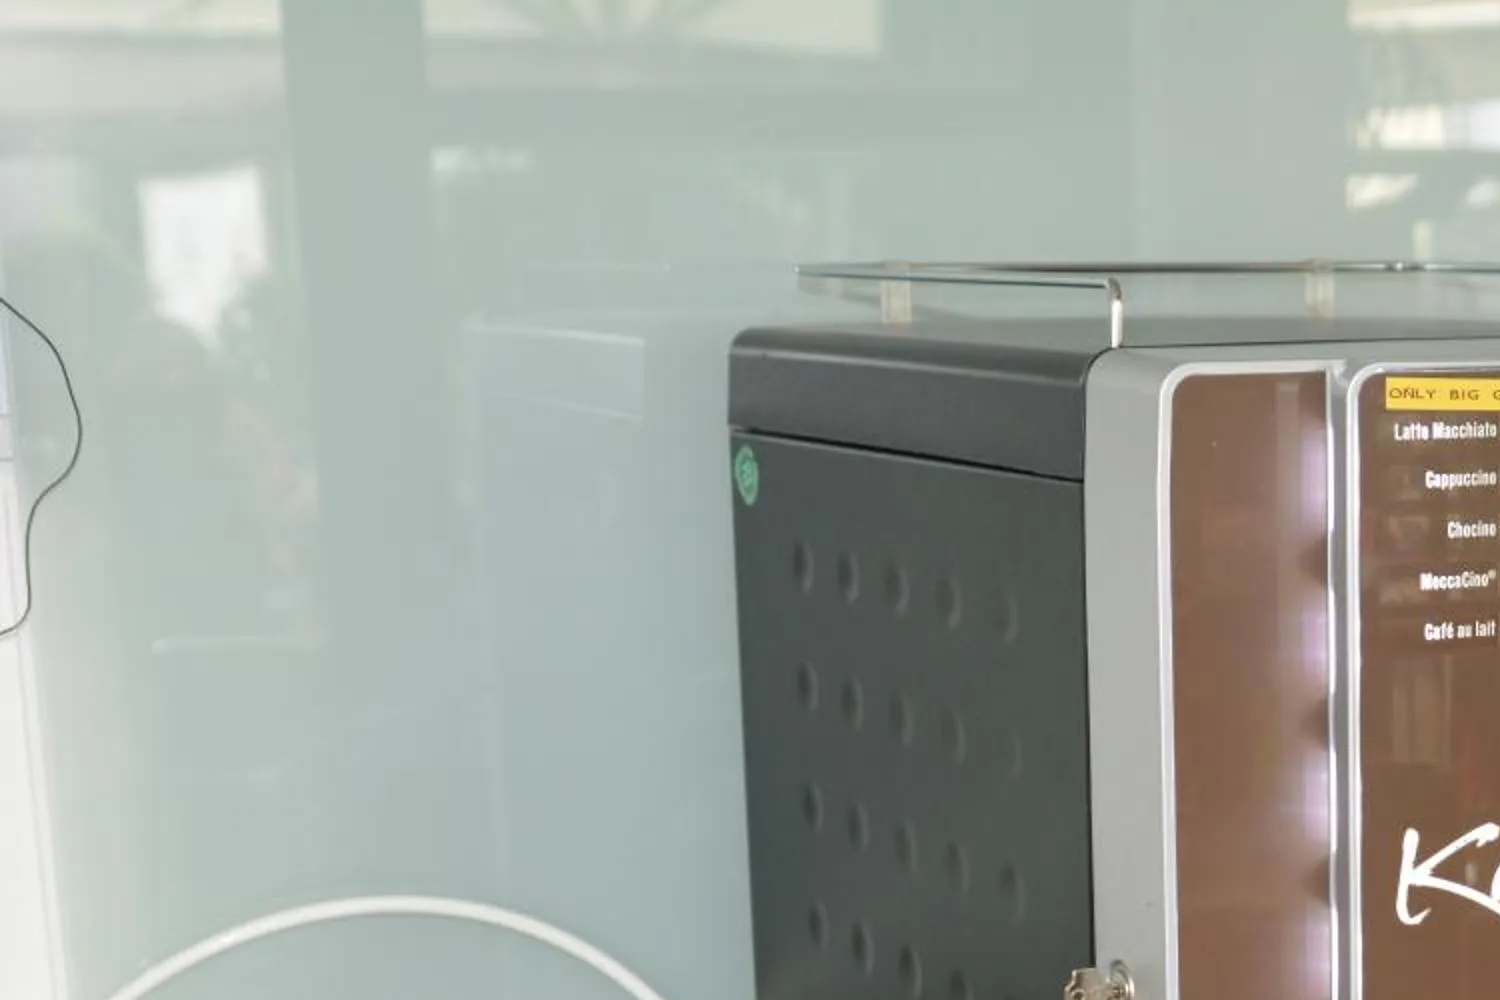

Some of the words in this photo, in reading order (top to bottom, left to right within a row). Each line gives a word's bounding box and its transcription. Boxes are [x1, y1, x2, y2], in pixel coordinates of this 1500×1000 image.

[1389, 386, 1437, 401] ONLY
[1449, 388, 1480, 401] BIG
[1432, 421, 1497, 441] Macchiato
[1424, 468, 1497, 491] Cappuccino
[1447, 520, 1497, 540] Chocino
[1423, 620, 1455, 642] Café
[1457, 625, 1473, 639] au
[1476, 620, 1496, 638] lait
